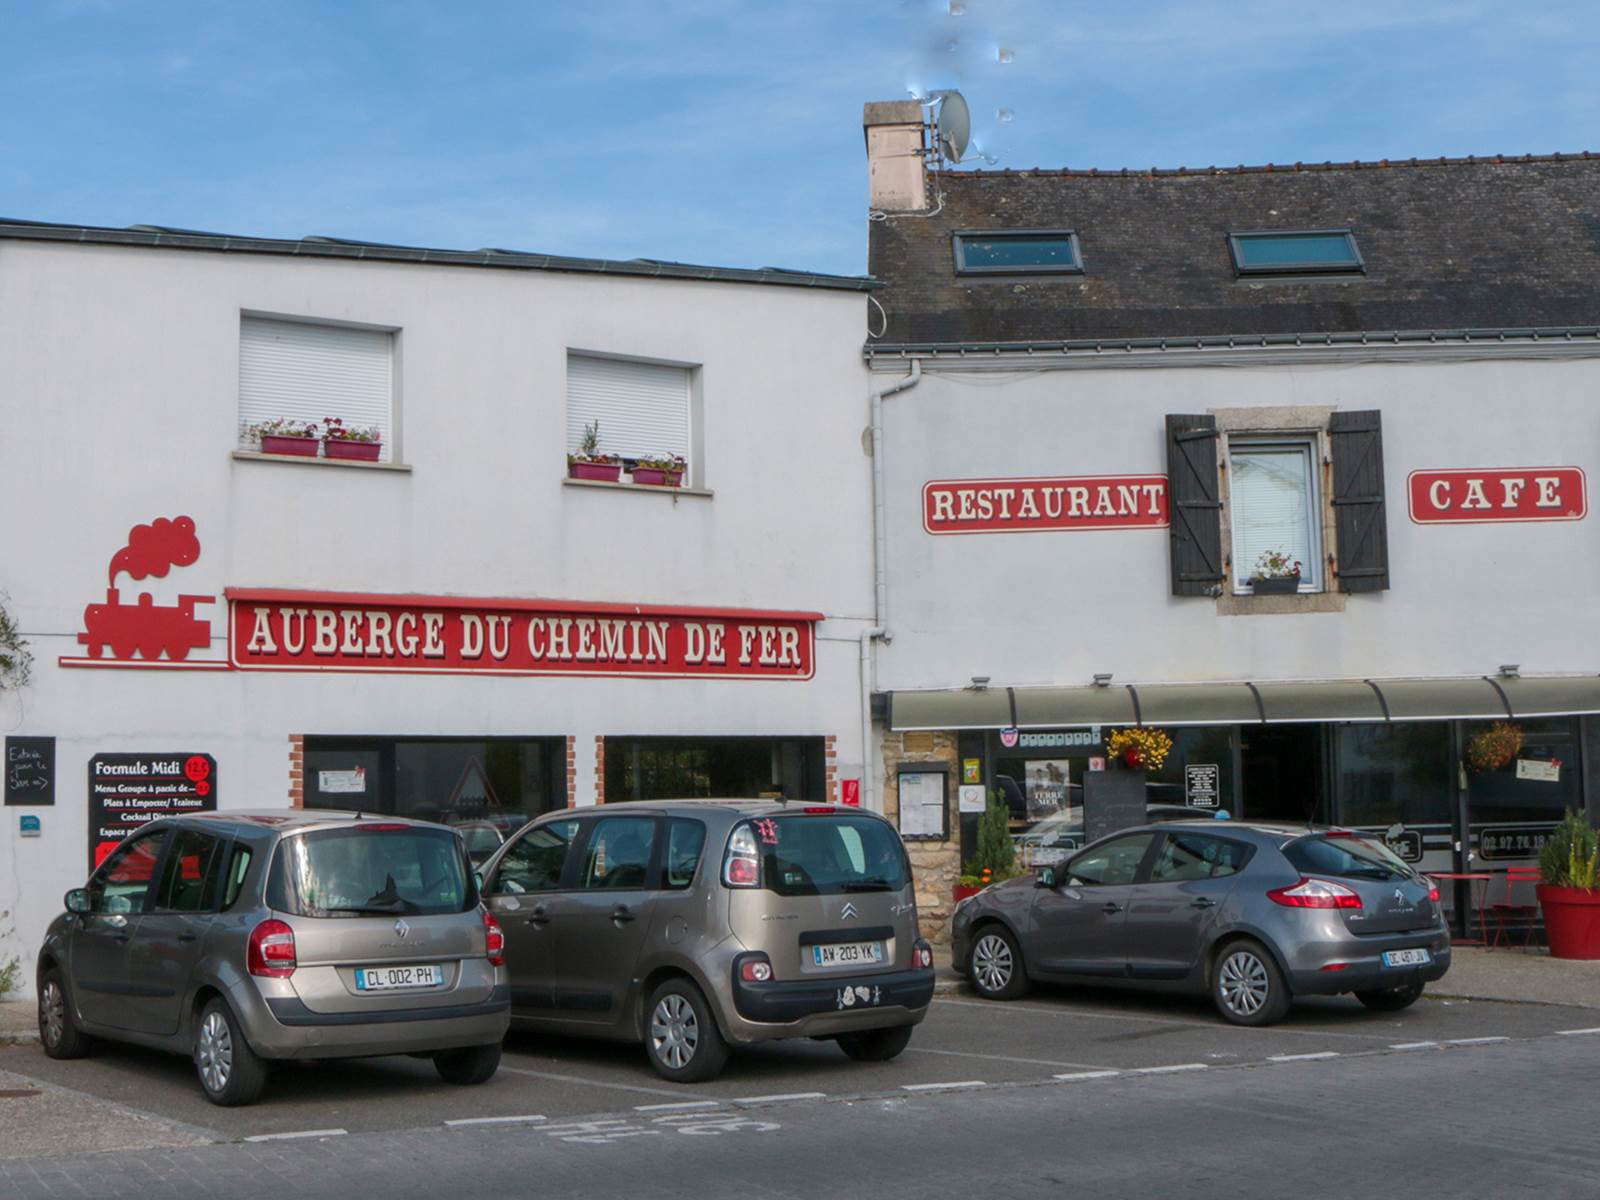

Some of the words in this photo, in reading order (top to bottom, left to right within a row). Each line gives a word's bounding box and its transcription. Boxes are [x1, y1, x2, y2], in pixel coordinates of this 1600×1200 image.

[1429, 477, 1562, 510] CAFE
[931, 484, 1164, 522] RESTAURANT
[246, 607, 446, 658] AUBERGE
[459, 614, 512, 660] DU
[526, 616, 670, 663] CHEMIN
[683, 622, 727, 665] DE
[737, 625, 802, 667] FER
[95, 761, 149, 775] Formule
[151, 761, 181, 775] Midi
[95, 784, 117, 793] Menu
[117, 784, 147, 795] Groupe
[1034, 791, 1063, 799] TERRE
[103, 799, 123, 807] Plats
[1039, 798, 1058, 806] MER
[120, 812, 151, 822] Cocktail
